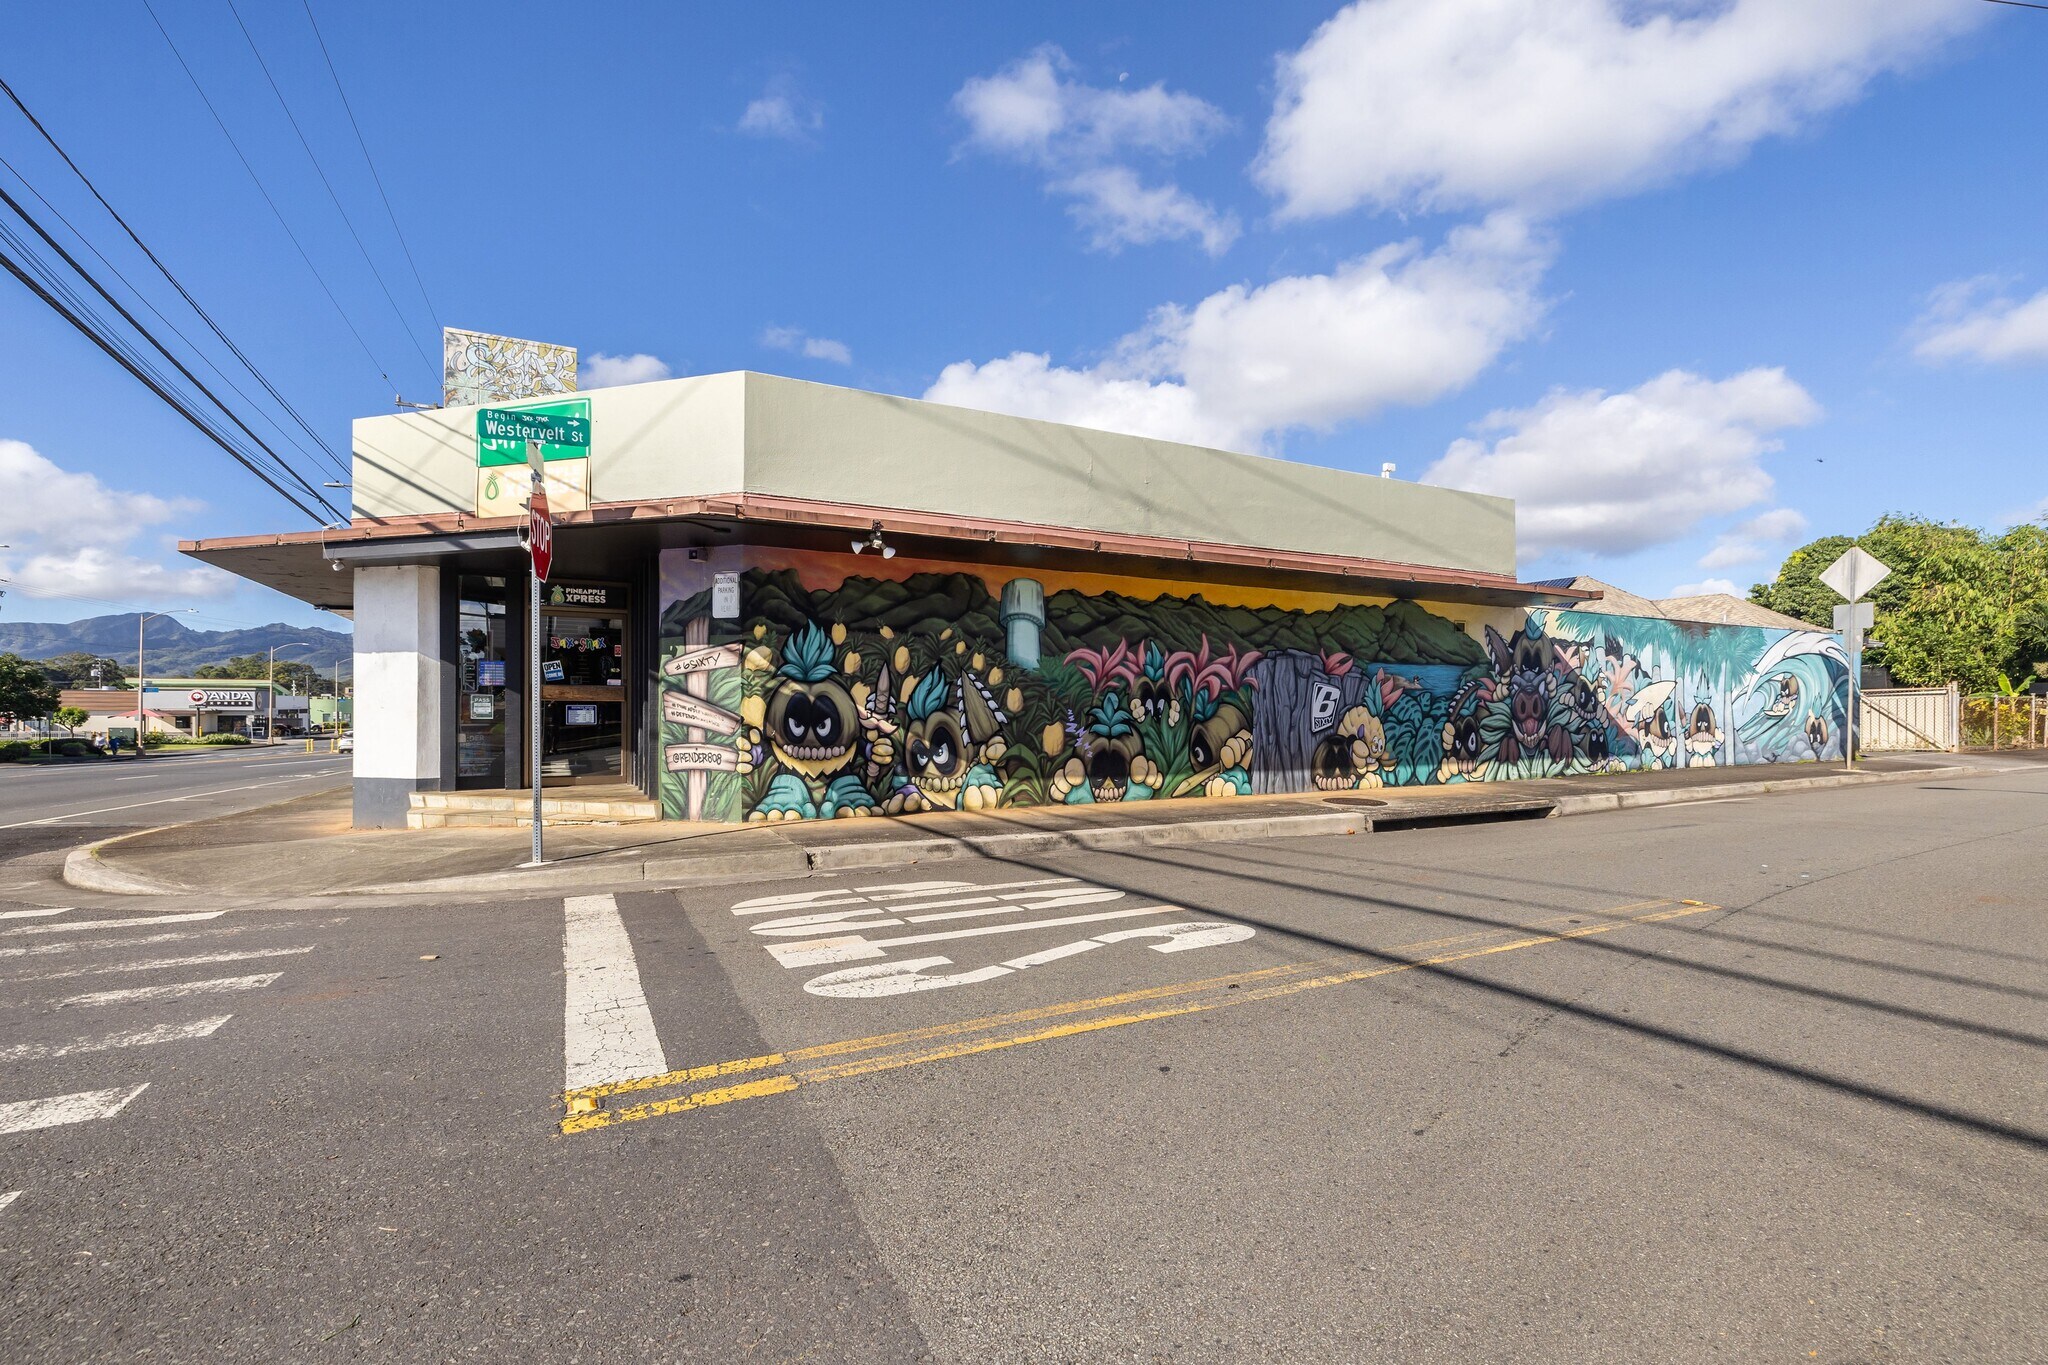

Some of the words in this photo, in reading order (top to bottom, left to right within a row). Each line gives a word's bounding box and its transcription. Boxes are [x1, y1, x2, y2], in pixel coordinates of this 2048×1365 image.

[487, 410, 516, 421] Begin
[485, 419, 565, 441] Westervelt
[571, 430, 584, 443] St
[531, 508, 550, 554] STOP
[565, 587, 606, 596] PINEAPPLE
[565, 594, 607, 604] XPRESS
[543, 661, 561, 671] OPEN
[675, 652, 721, 671] #6SIXTY
[206, 690, 252, 700] ANDA
[1314, 716, 1333, 730] SIXTY
